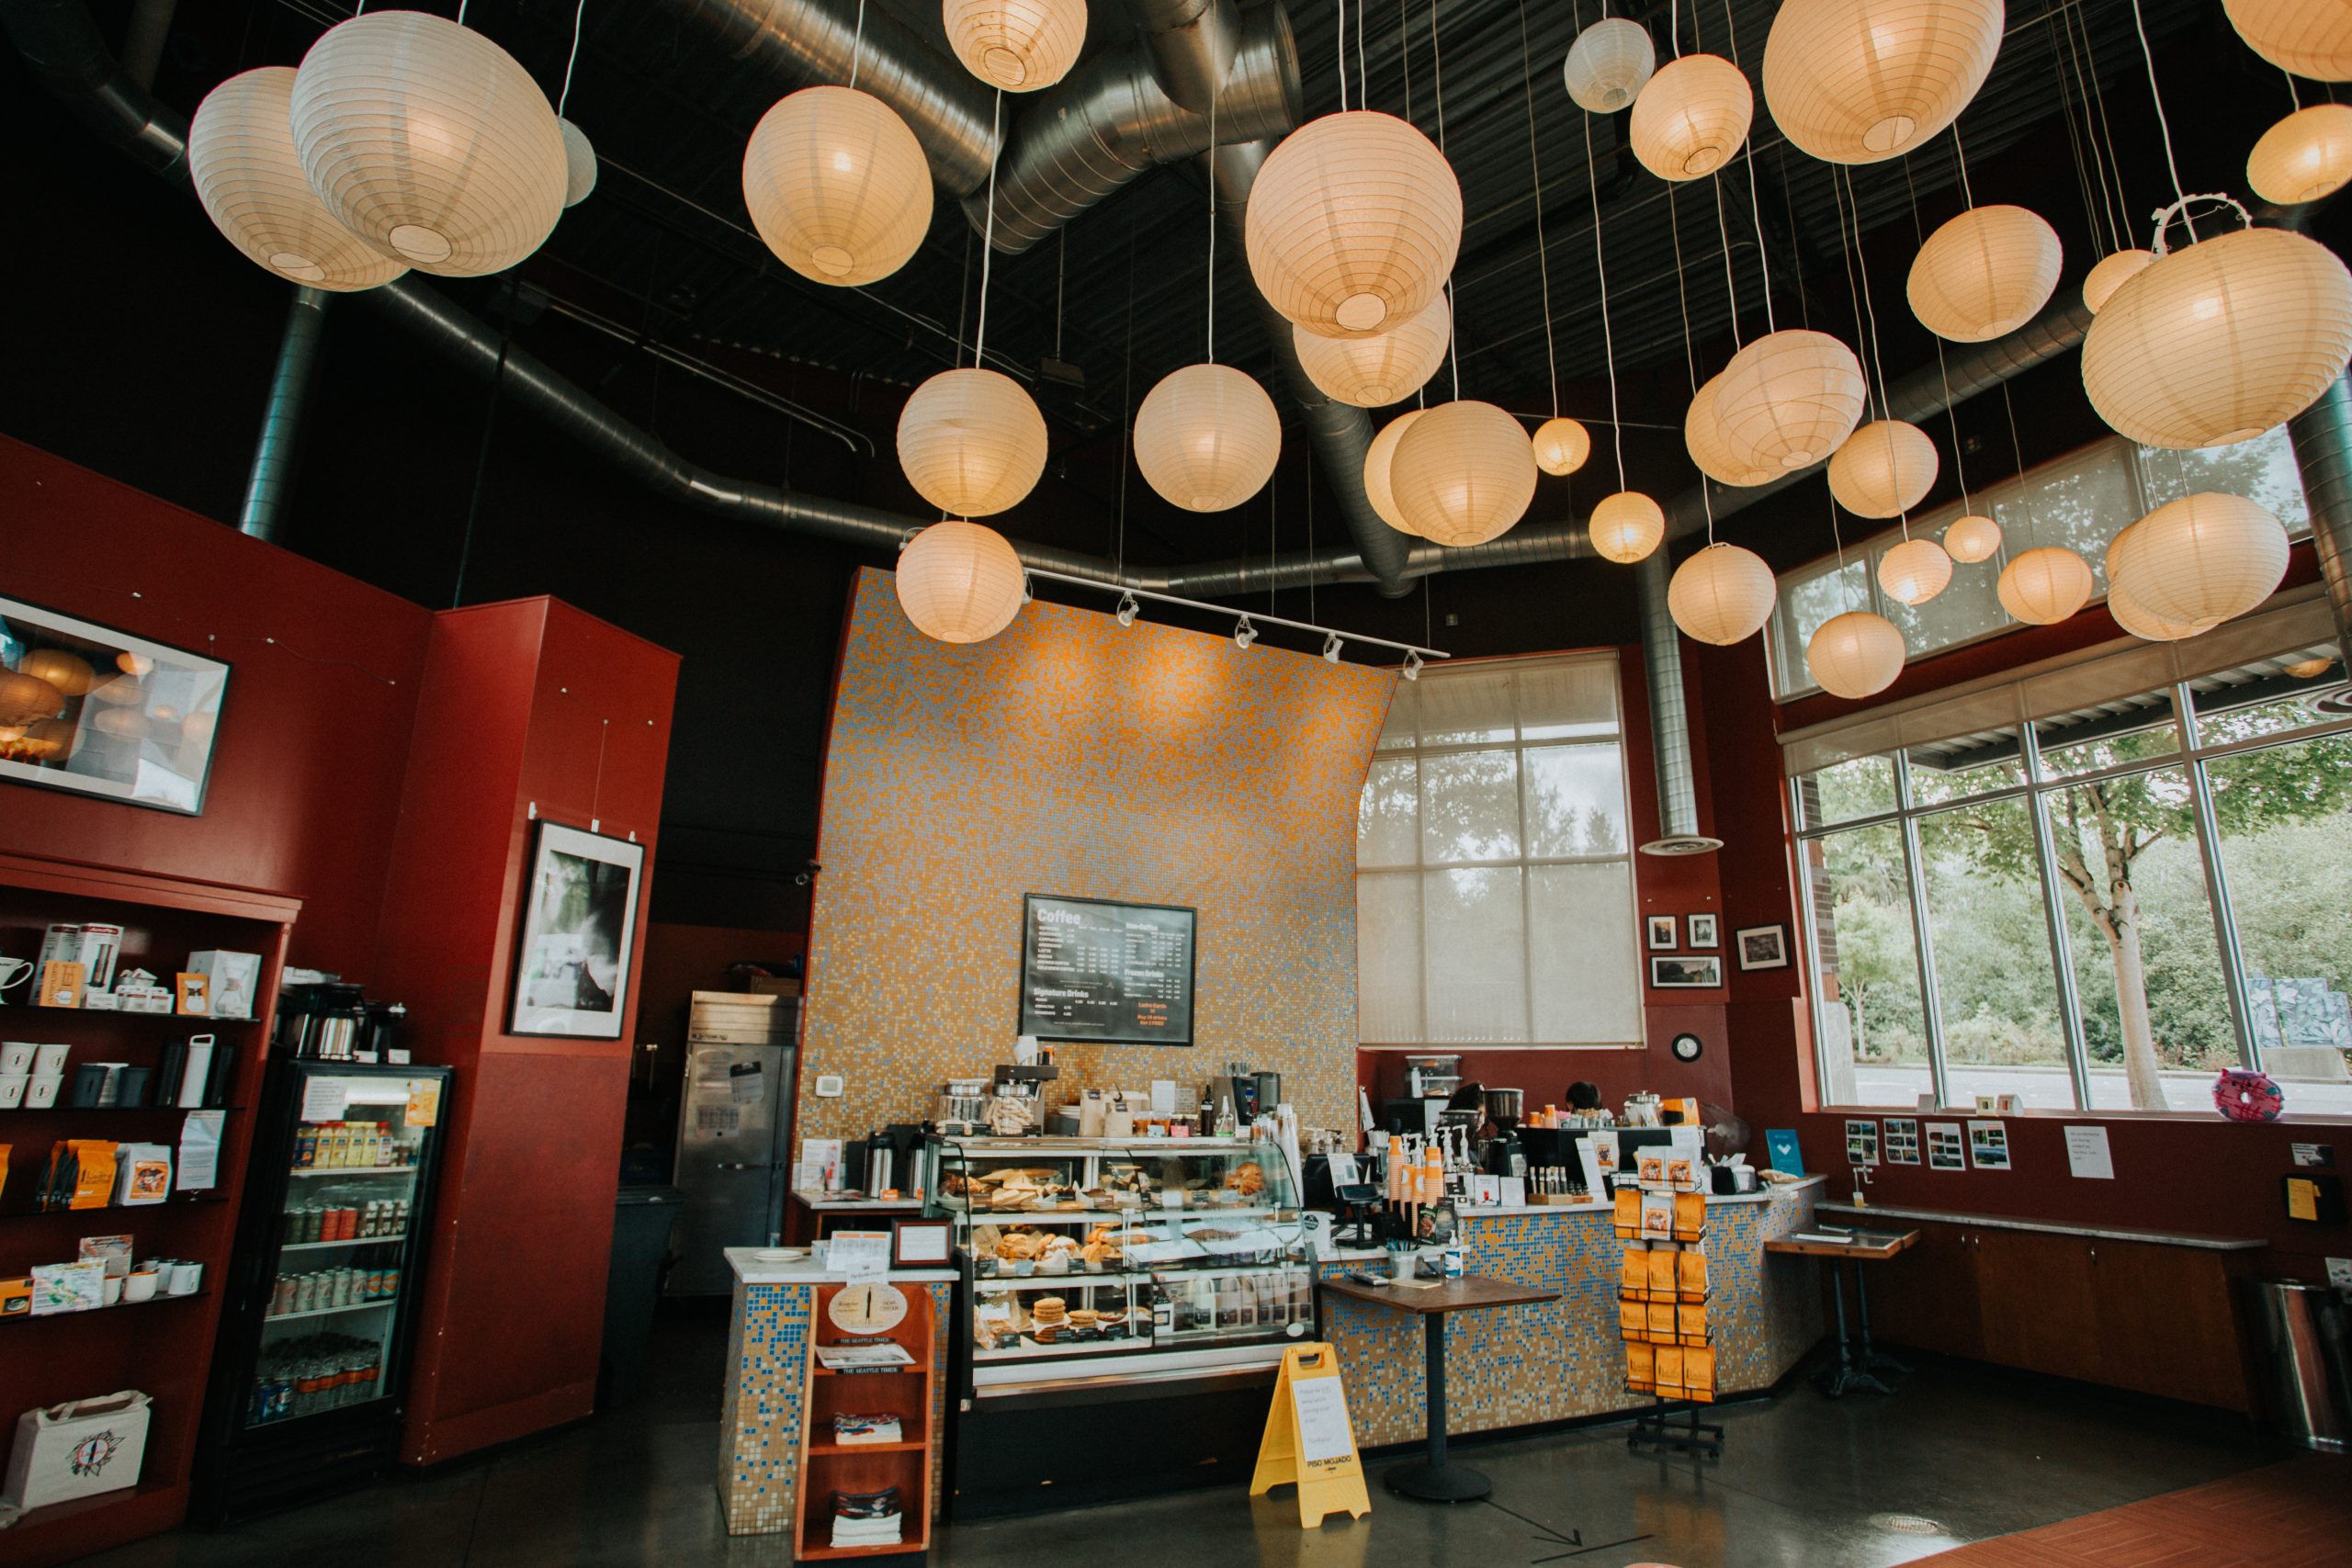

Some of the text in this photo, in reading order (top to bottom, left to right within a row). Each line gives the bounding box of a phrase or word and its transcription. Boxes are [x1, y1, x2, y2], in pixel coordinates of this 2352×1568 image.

[1037, 908, 1081, 925] Coffee
[1033, 987, 1066, 998] Signature
[1067, 989, 1089, 998] Drinks
[1307, 1455, 1351, 1468] PISO MOJADO
